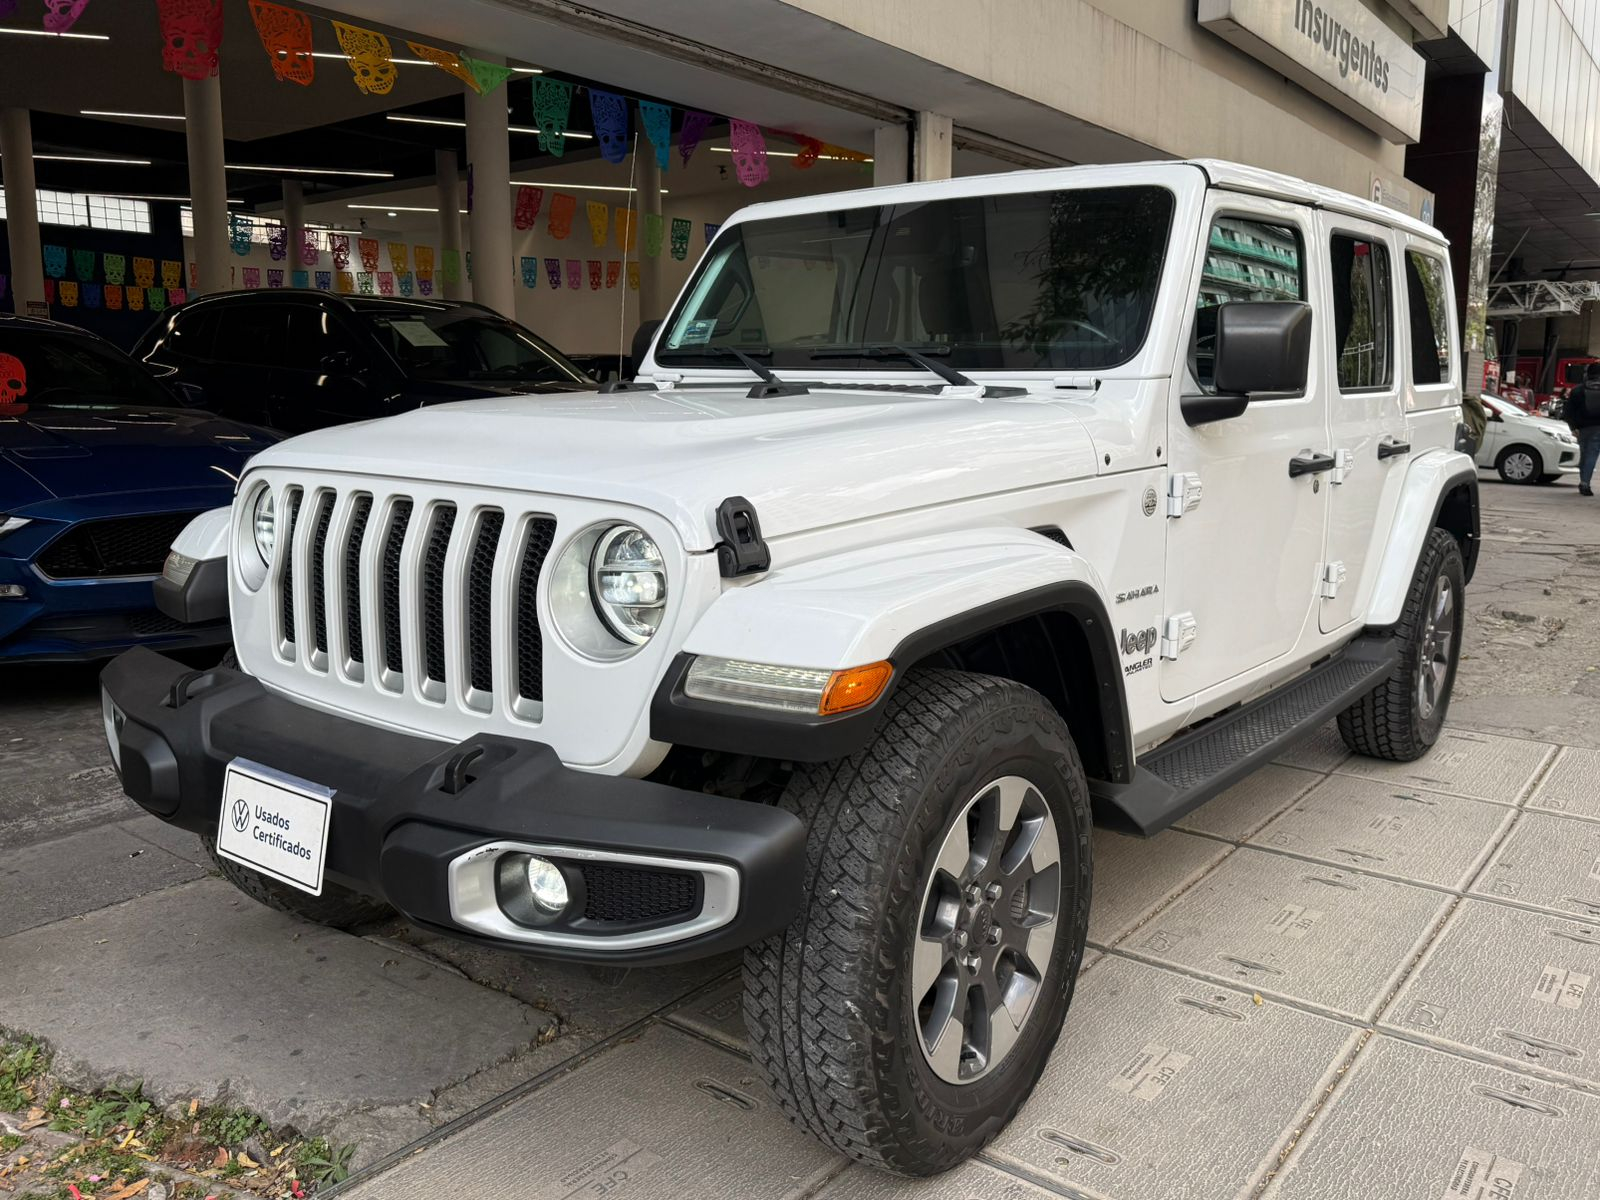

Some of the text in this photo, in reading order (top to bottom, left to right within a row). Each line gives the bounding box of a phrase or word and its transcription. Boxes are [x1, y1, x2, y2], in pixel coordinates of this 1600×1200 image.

[1295, 0, 1389, 93] Insurgentes
[1116, 585, 1159, 604] SAHARA
[1121, 626, 1157, 656] Jeep
[255, 804, 290, 831] Usados
[253, 825, 312, 860] Certificados
[1150, 1066, 1176, 1086] CFE
[590, 1169, 628, 1196] CFE
